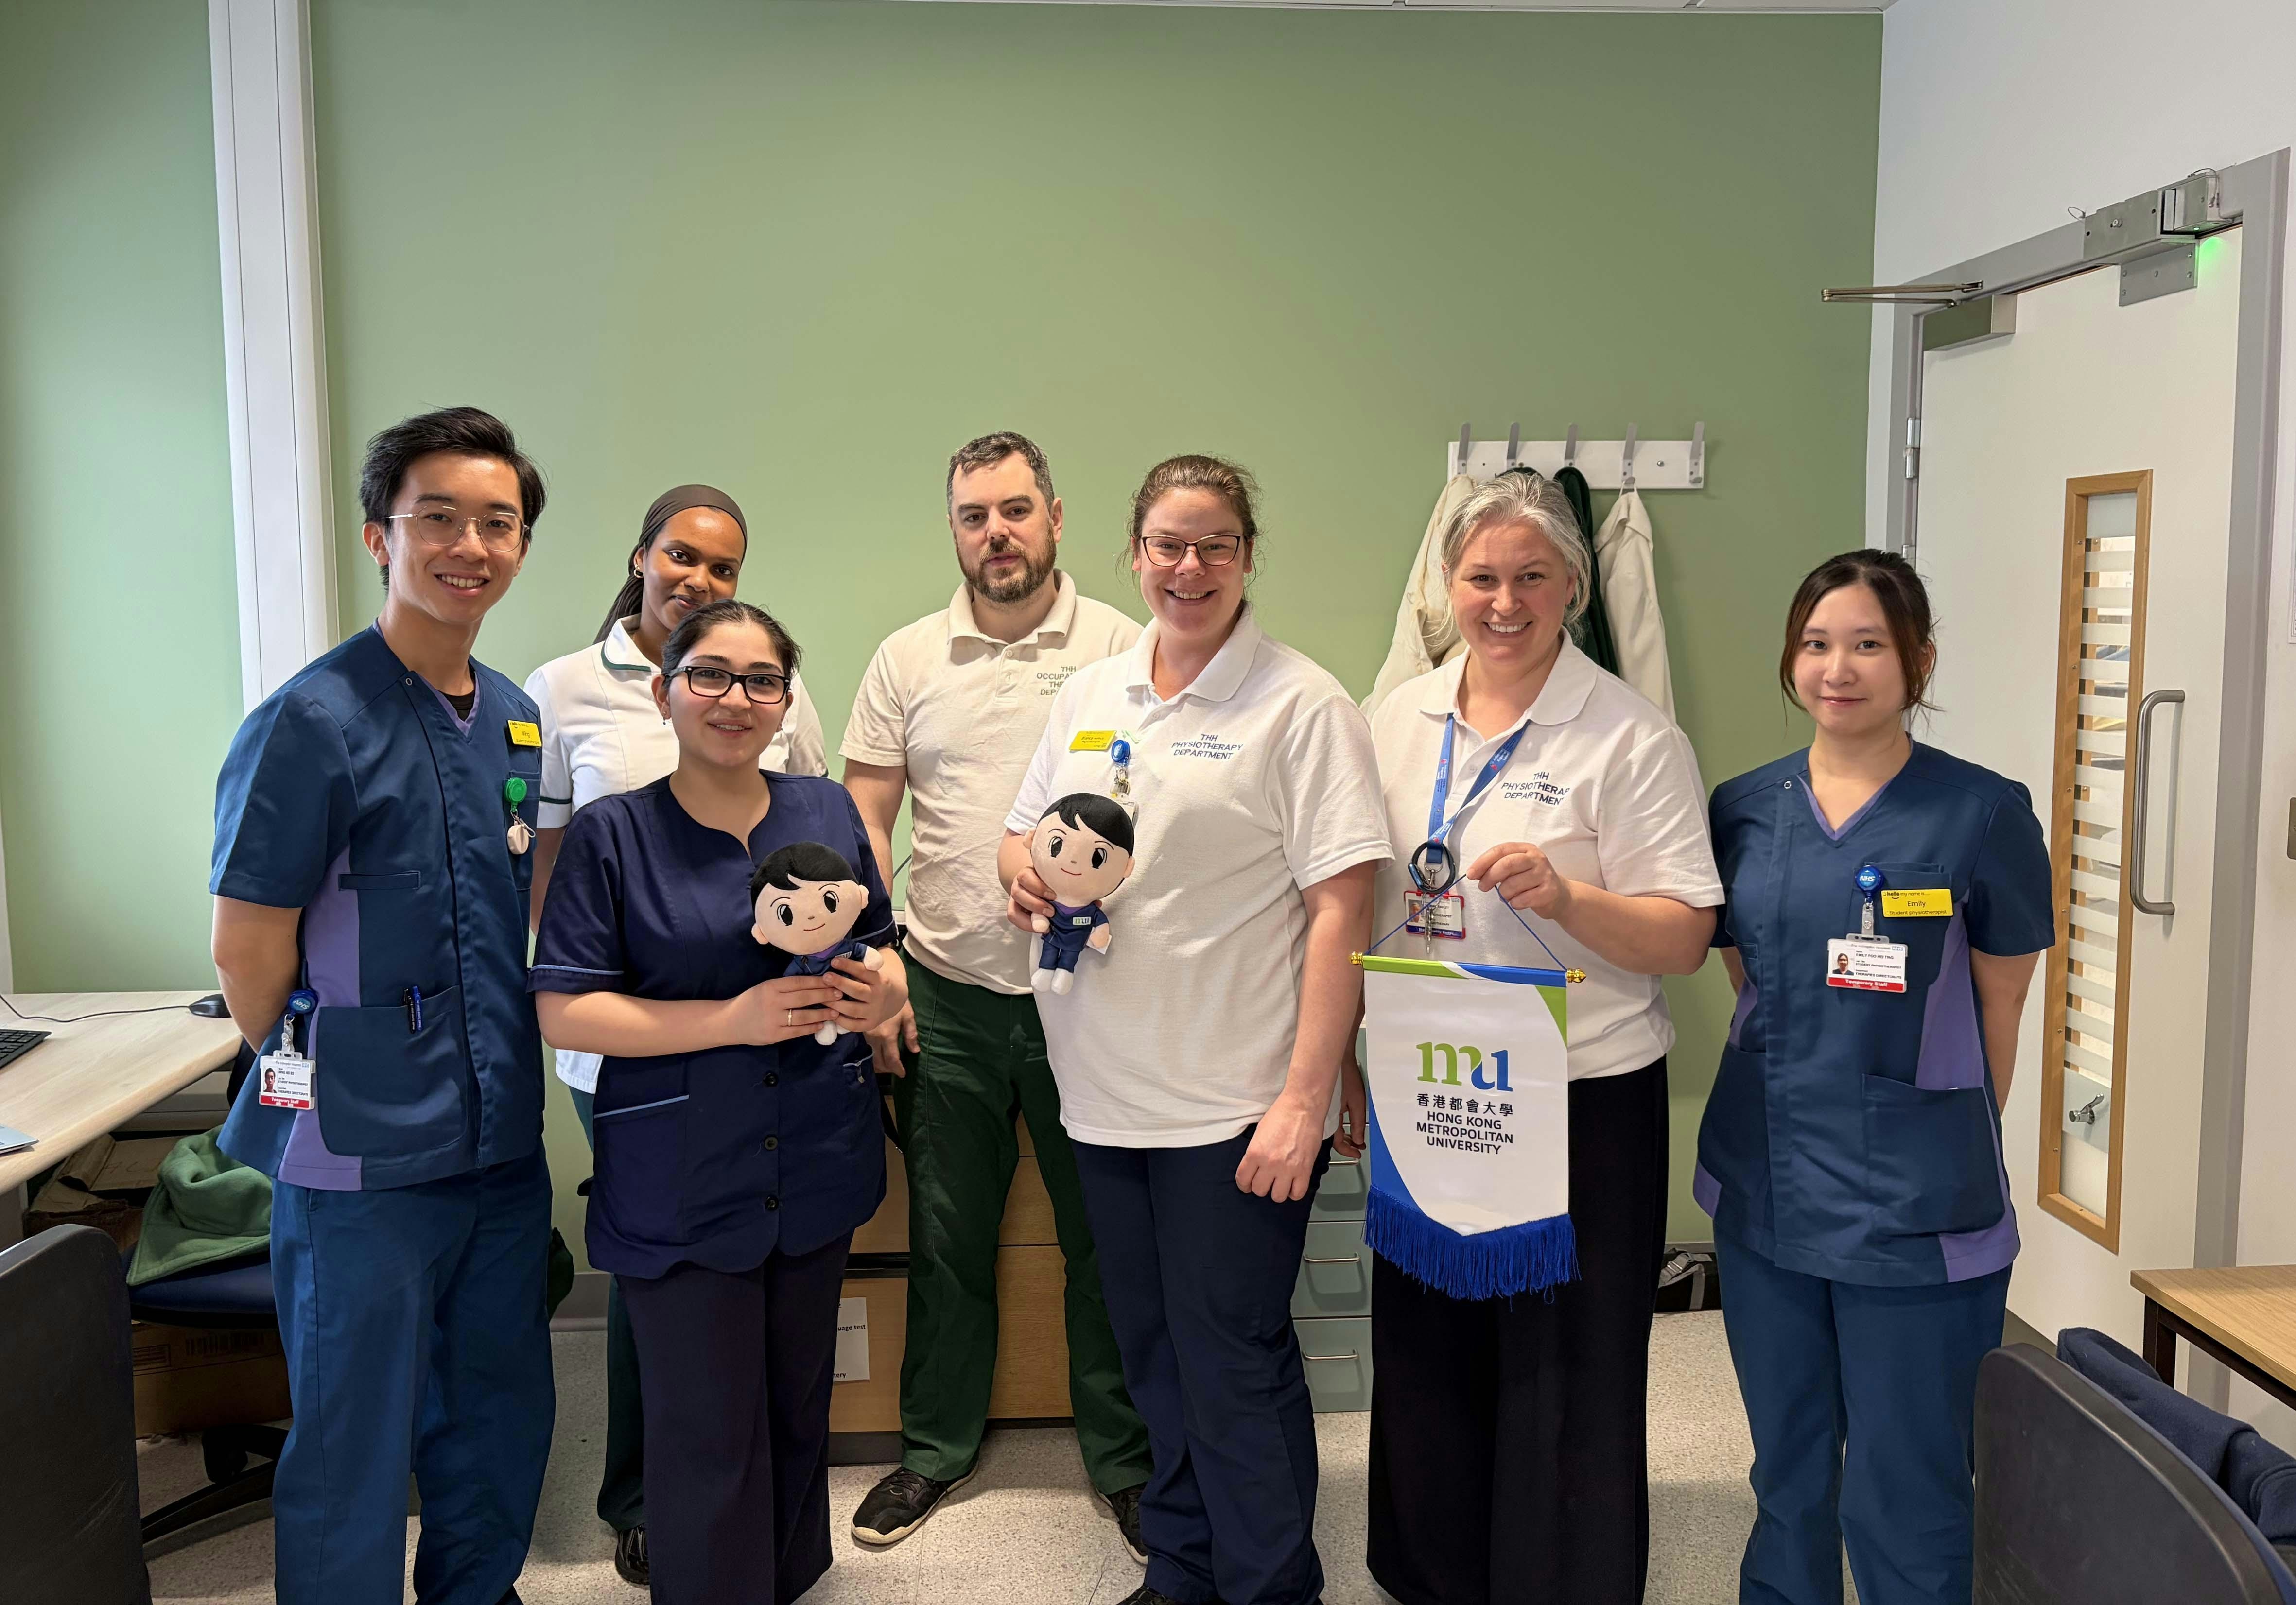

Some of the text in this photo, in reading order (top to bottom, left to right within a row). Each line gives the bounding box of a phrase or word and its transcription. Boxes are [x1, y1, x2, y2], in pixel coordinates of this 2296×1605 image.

[1171, 742, 1243, 751] PHYSIOTHERAPY
[1174, 749, 1233, 759] DEPARTMENT
[1533, 771, 1549, 780] THH
[293, 999, 310, 1009] NHS
[1416, 1041, 1513, 1092] mu
[1417, 1093, 1513, 1117] 香港都會大學
[1427, 1111, 1501, 1129] HONG KONG
[1417, 1122, 1513, 1143] METROPOLITAN
[1427, 1136, 1501, 1155] UNIVERSITY
